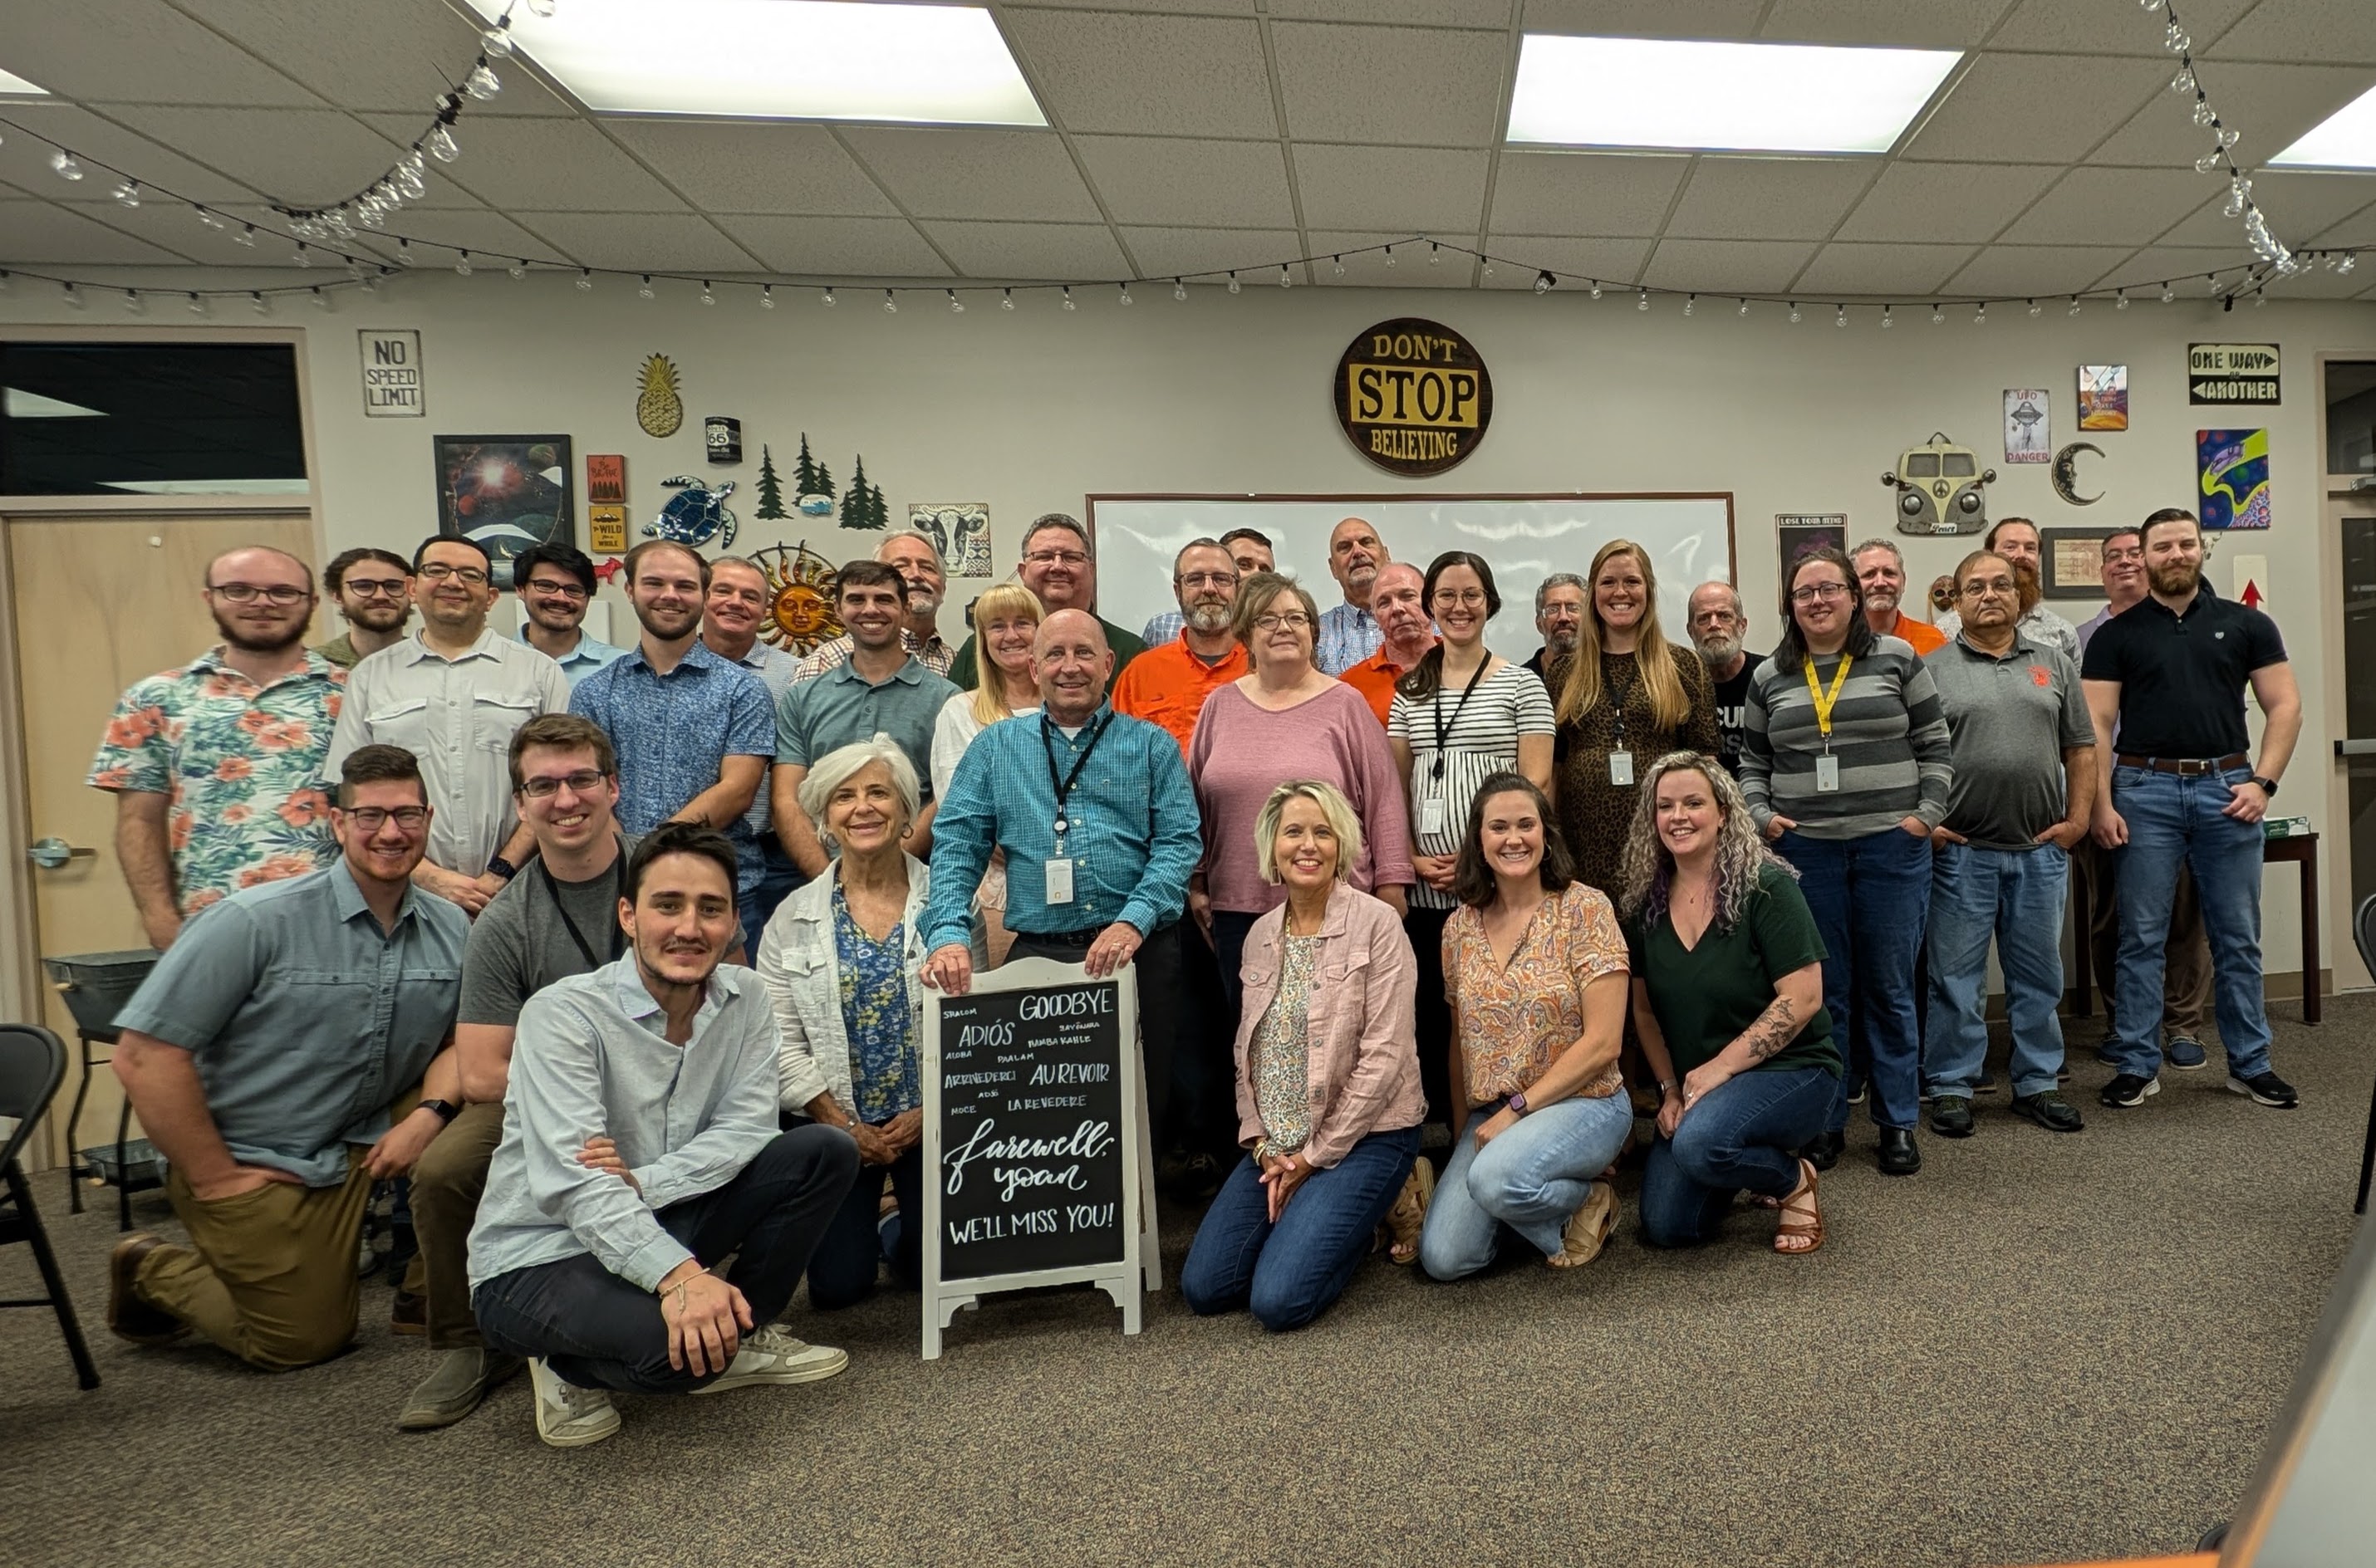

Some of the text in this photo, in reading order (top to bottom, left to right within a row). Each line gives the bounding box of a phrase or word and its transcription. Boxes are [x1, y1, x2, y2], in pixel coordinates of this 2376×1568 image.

[374, 341, 405, 365] NO
[1373, 334, 1457, 362] DON'T
[2192, 352, 2264, 370] ONE WAY
[367, 369, 417, 385] SPEED
[369, 388, 418, 406] LIMIT
[1358, 368, 1475, 422] STOP
[2017, 391, 2038, 400] UFO
[2207, 382, 2277, 399] ANOTHER
[709, 433, 727, 444] 66
[1371, 429, 1457, 460] BELIEVING
[2007, 453, 2049, 462] DANGER
[599, 525, 622, 534] WILD
[1822, 517, 1843, 525] MIND
[943, 1007, 977, 1019] SHALOM
[1019, 988, 1113, 1021] GOODBYE
[959, 1018, 1015, 1047] ADIÓS
[1060, 1036, 1091, 1045] KAHLE
[945, 1050, 972, 1061] ALOHA
[997, 1052, 1034, 1063] PAALAM
[945, 1071, 1016, 1089] ARRIVEDERCI
[1029, 1063, 1110, 1085] AU REVOIR
[951, 1105, 977, 1115] MOCE
[1008, 1095, 1087, 1112] LA REVEDERE
[950, 1203, 1114, 1245] WE'LL MISS YOU!
